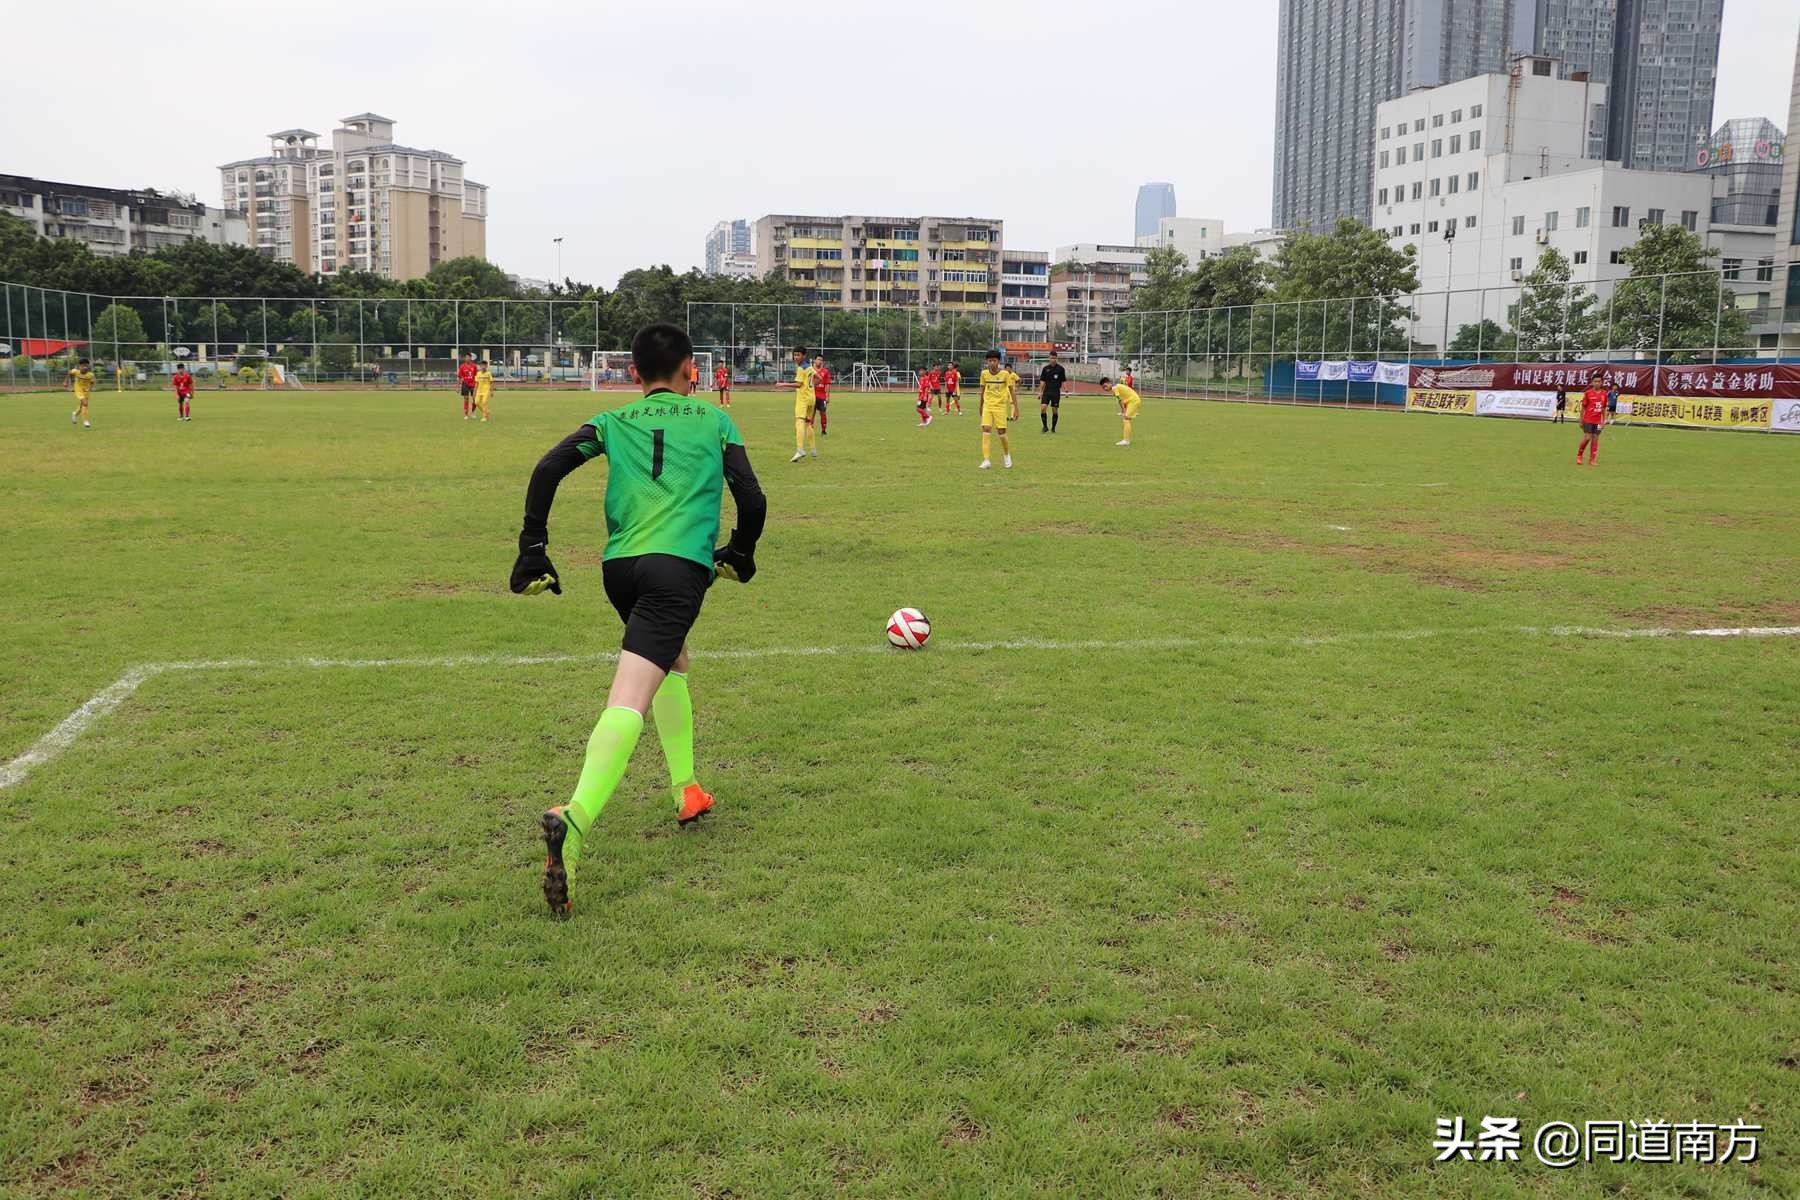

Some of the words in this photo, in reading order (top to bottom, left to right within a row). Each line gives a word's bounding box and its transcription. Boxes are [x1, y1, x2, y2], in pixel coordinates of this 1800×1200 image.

[1513, 368, 1638, 389] 中国足球发展基会资助
[1666, 371, 1775, 391] 彩票公益金资助
[651, 428, 665, 481] 1
